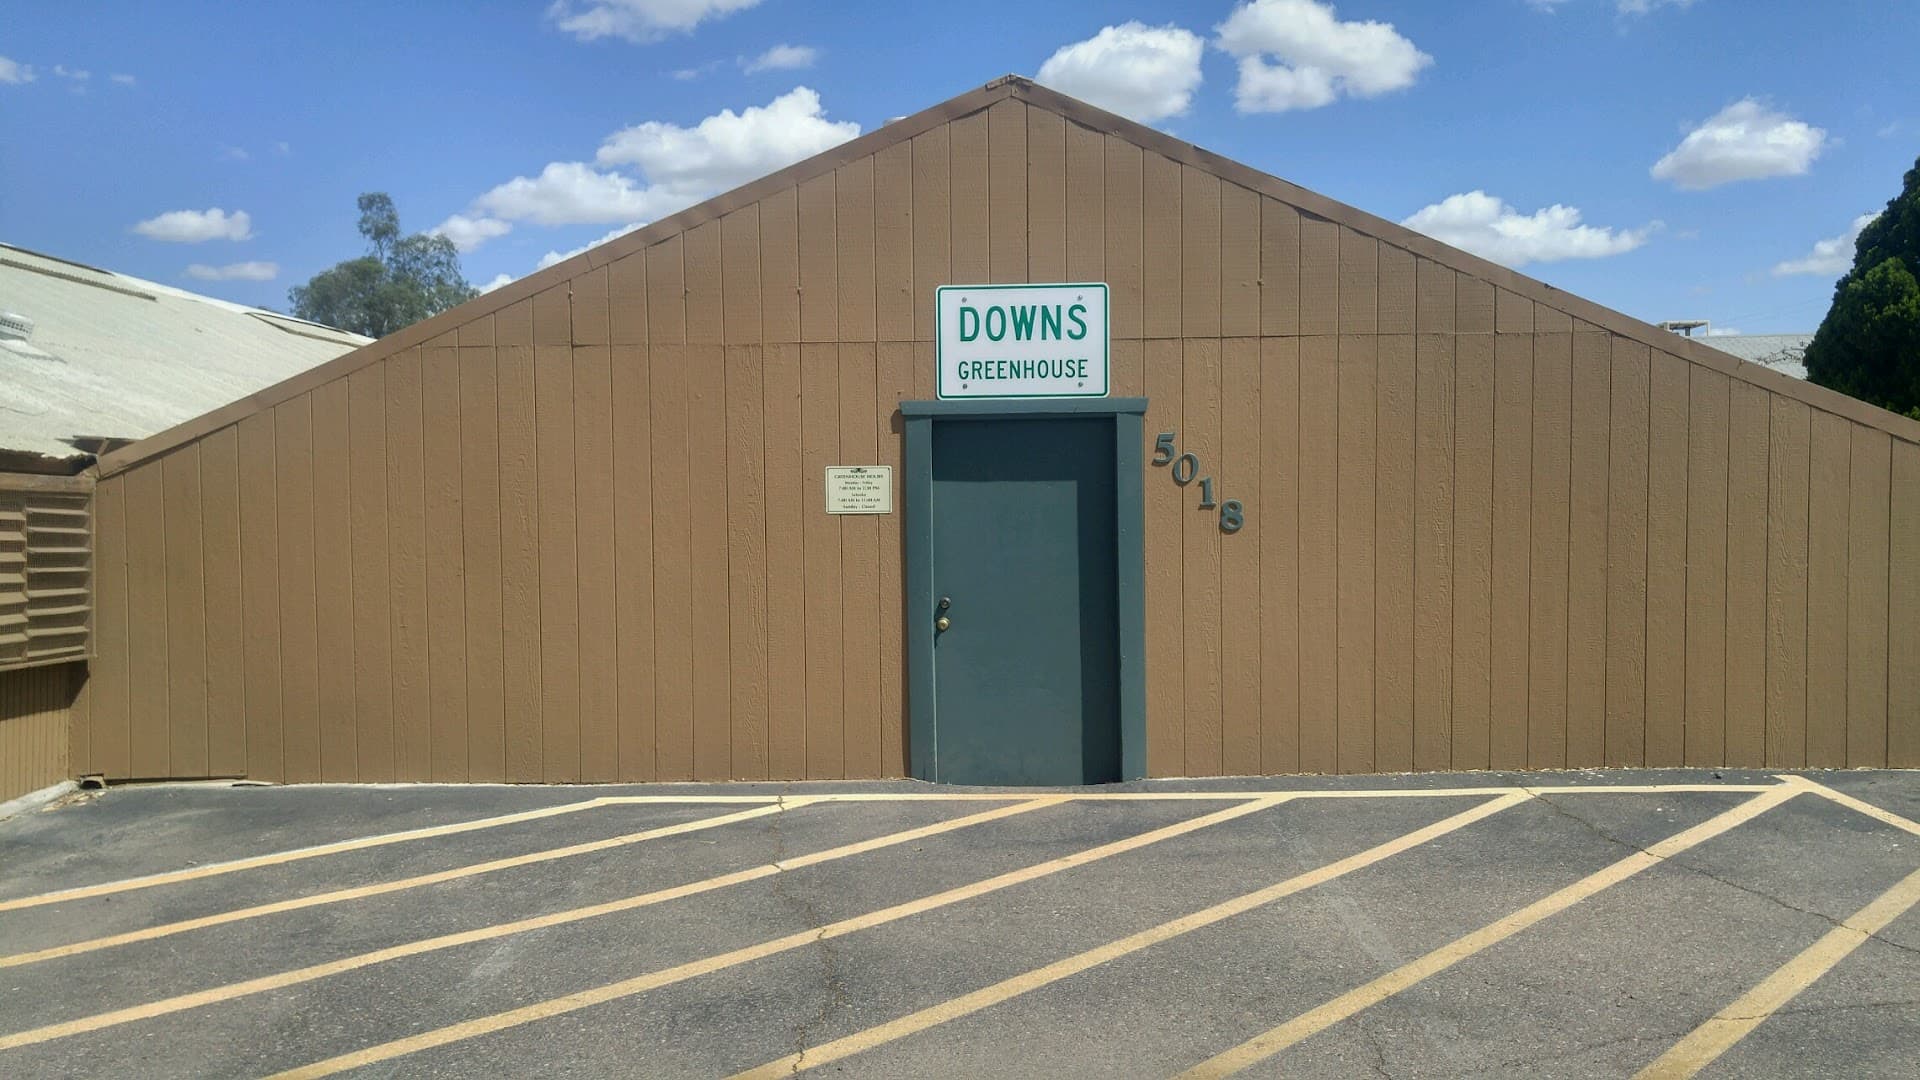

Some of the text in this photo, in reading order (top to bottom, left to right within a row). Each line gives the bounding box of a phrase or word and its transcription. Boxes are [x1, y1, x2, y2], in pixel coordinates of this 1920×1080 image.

[959, 304, 1088, 342] DOWNS
[958, 359, 1089, 380] GREENHOUSE
[1151, 432, 1244, 535] 5018
